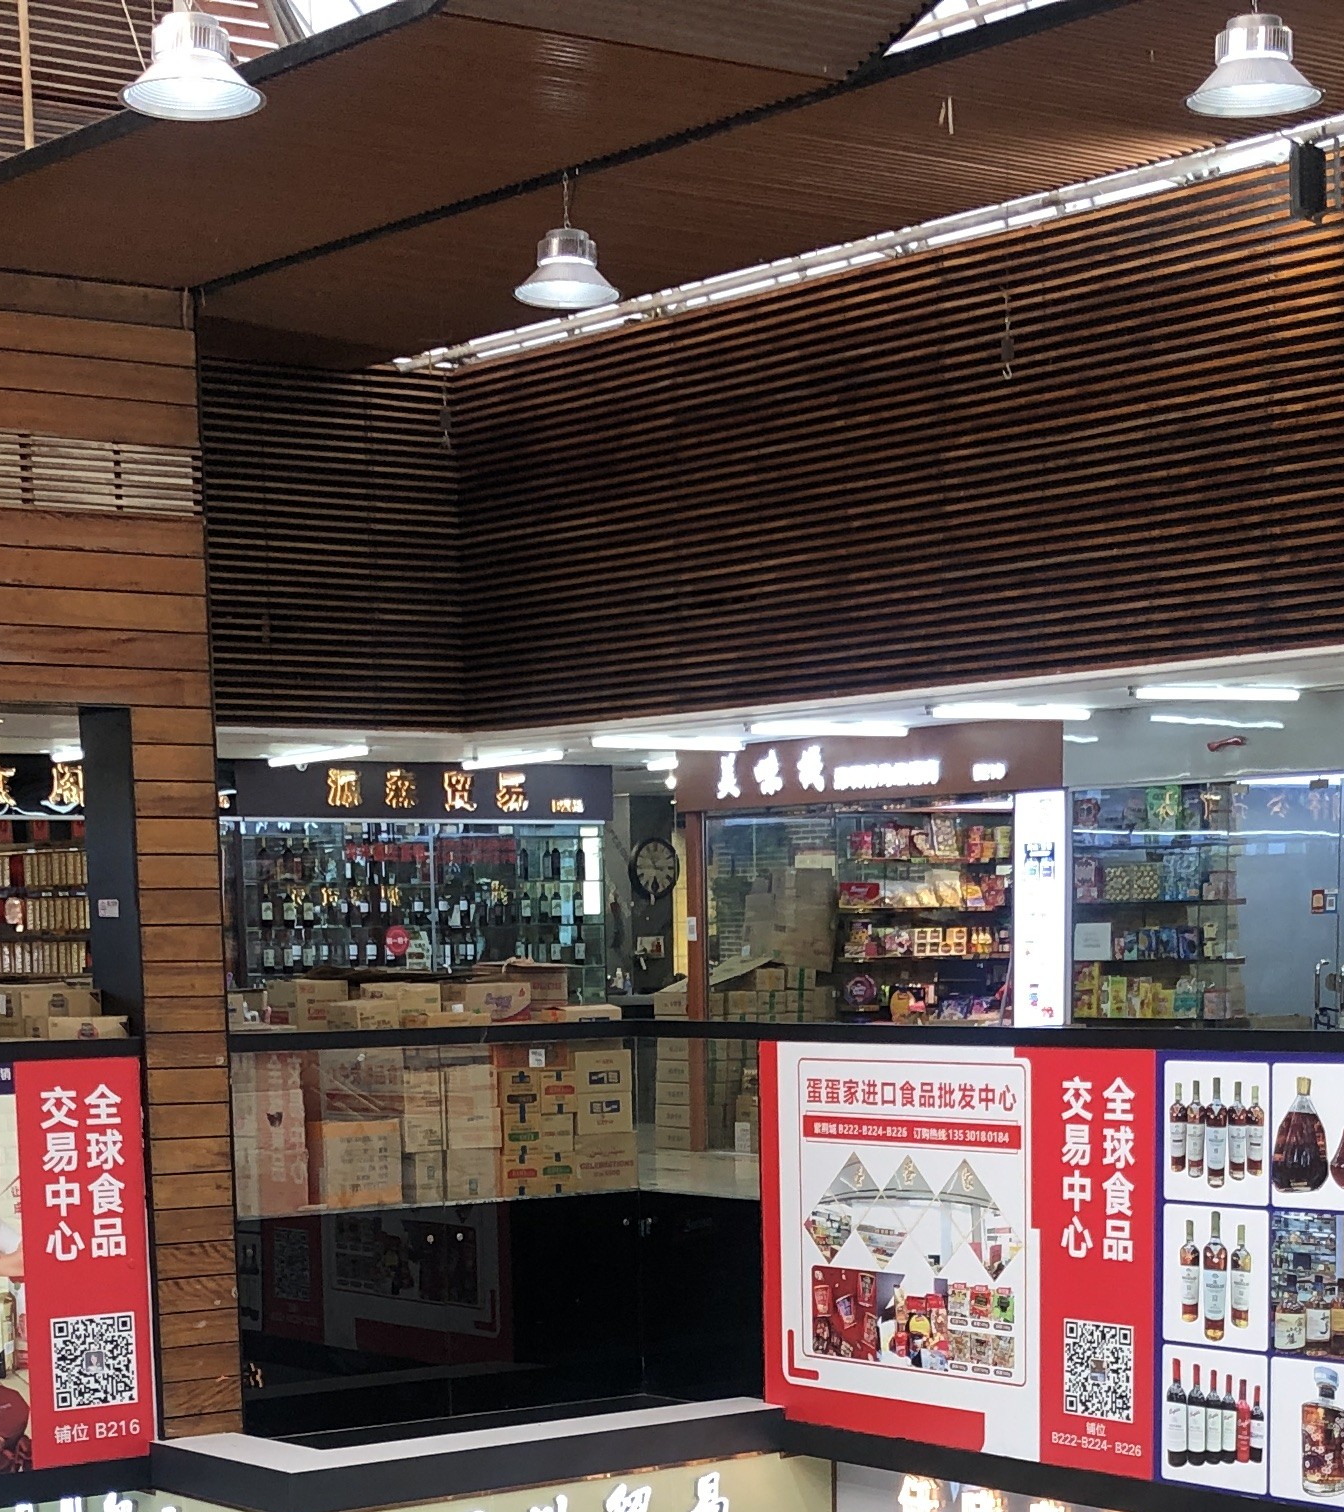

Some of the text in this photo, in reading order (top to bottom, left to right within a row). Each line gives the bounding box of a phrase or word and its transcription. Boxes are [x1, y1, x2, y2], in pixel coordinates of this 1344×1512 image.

[40, 1087, 86, 1263] 交易中心
[83, 1084, 128, 1260] 全球食品
[806, 1078, 1017, 1112] 蛋蛋家进口食品批发中心
[1061, 1076, 1094, 1259] 交易中心
[1102, 1077, 1136, 1263] 全球食品
[54, 1419, 141, 1444] 铺位 B216
[1114, 1442, 1142, 1458] B226
